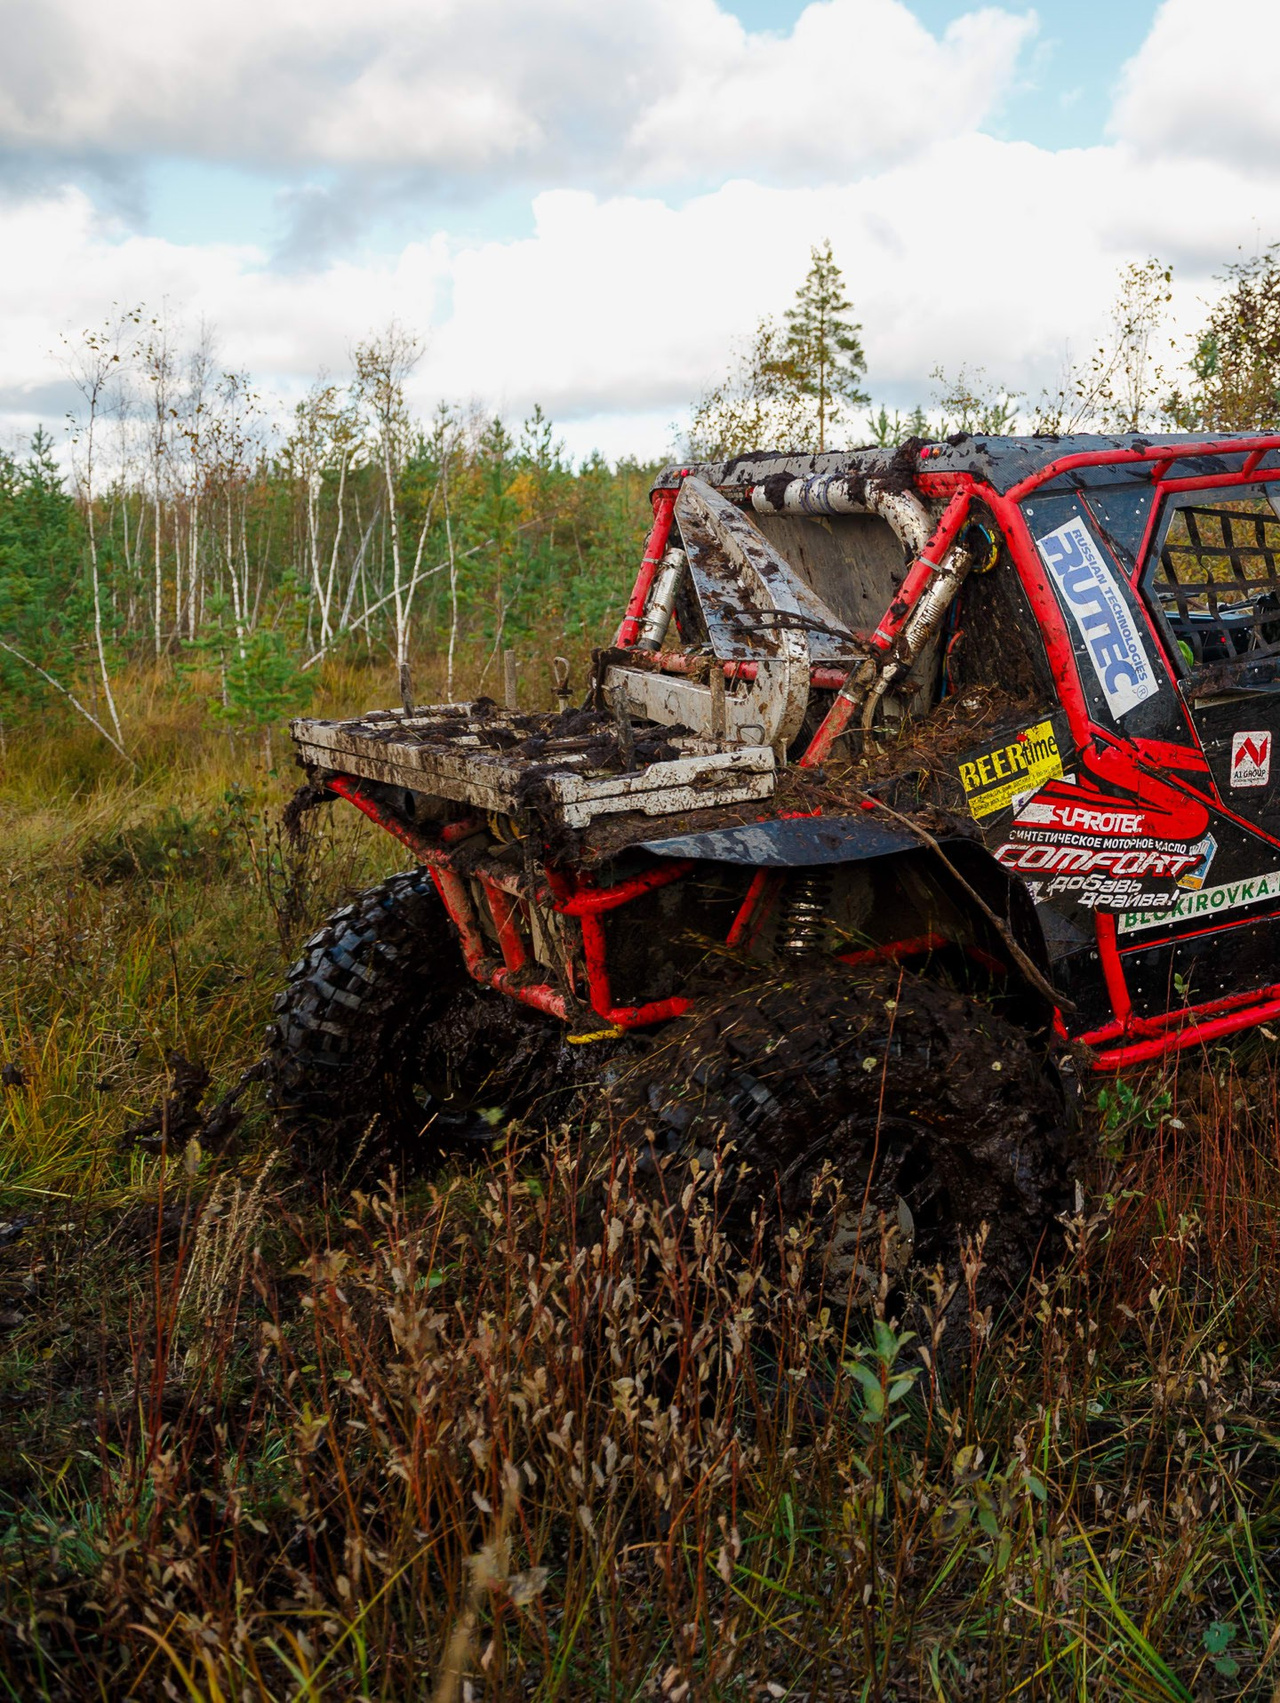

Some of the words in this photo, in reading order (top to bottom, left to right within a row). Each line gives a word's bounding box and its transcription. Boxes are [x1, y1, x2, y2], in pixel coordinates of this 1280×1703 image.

[1040, 531, 1140, 695] RUTEC
[1072, 529, 1108, 585] RUSSIAN
[1104, 587, 1148, 682] TECHNOLOGIES
[1053, 806, 1145, 833] SUPROTEC
[1009, 830, 1102, 848] СИНТЕТИЧЕСКОЕ
[1103, 838, 1154, 850] МОТОРНОЕ
[1155, 840, 1187, 854] МАСЛО
[993, 843, 1197, 875] COMFORT
[1046, 873, 1142, 897] добавь
[1077, 889, 1180, 909] драйва!
